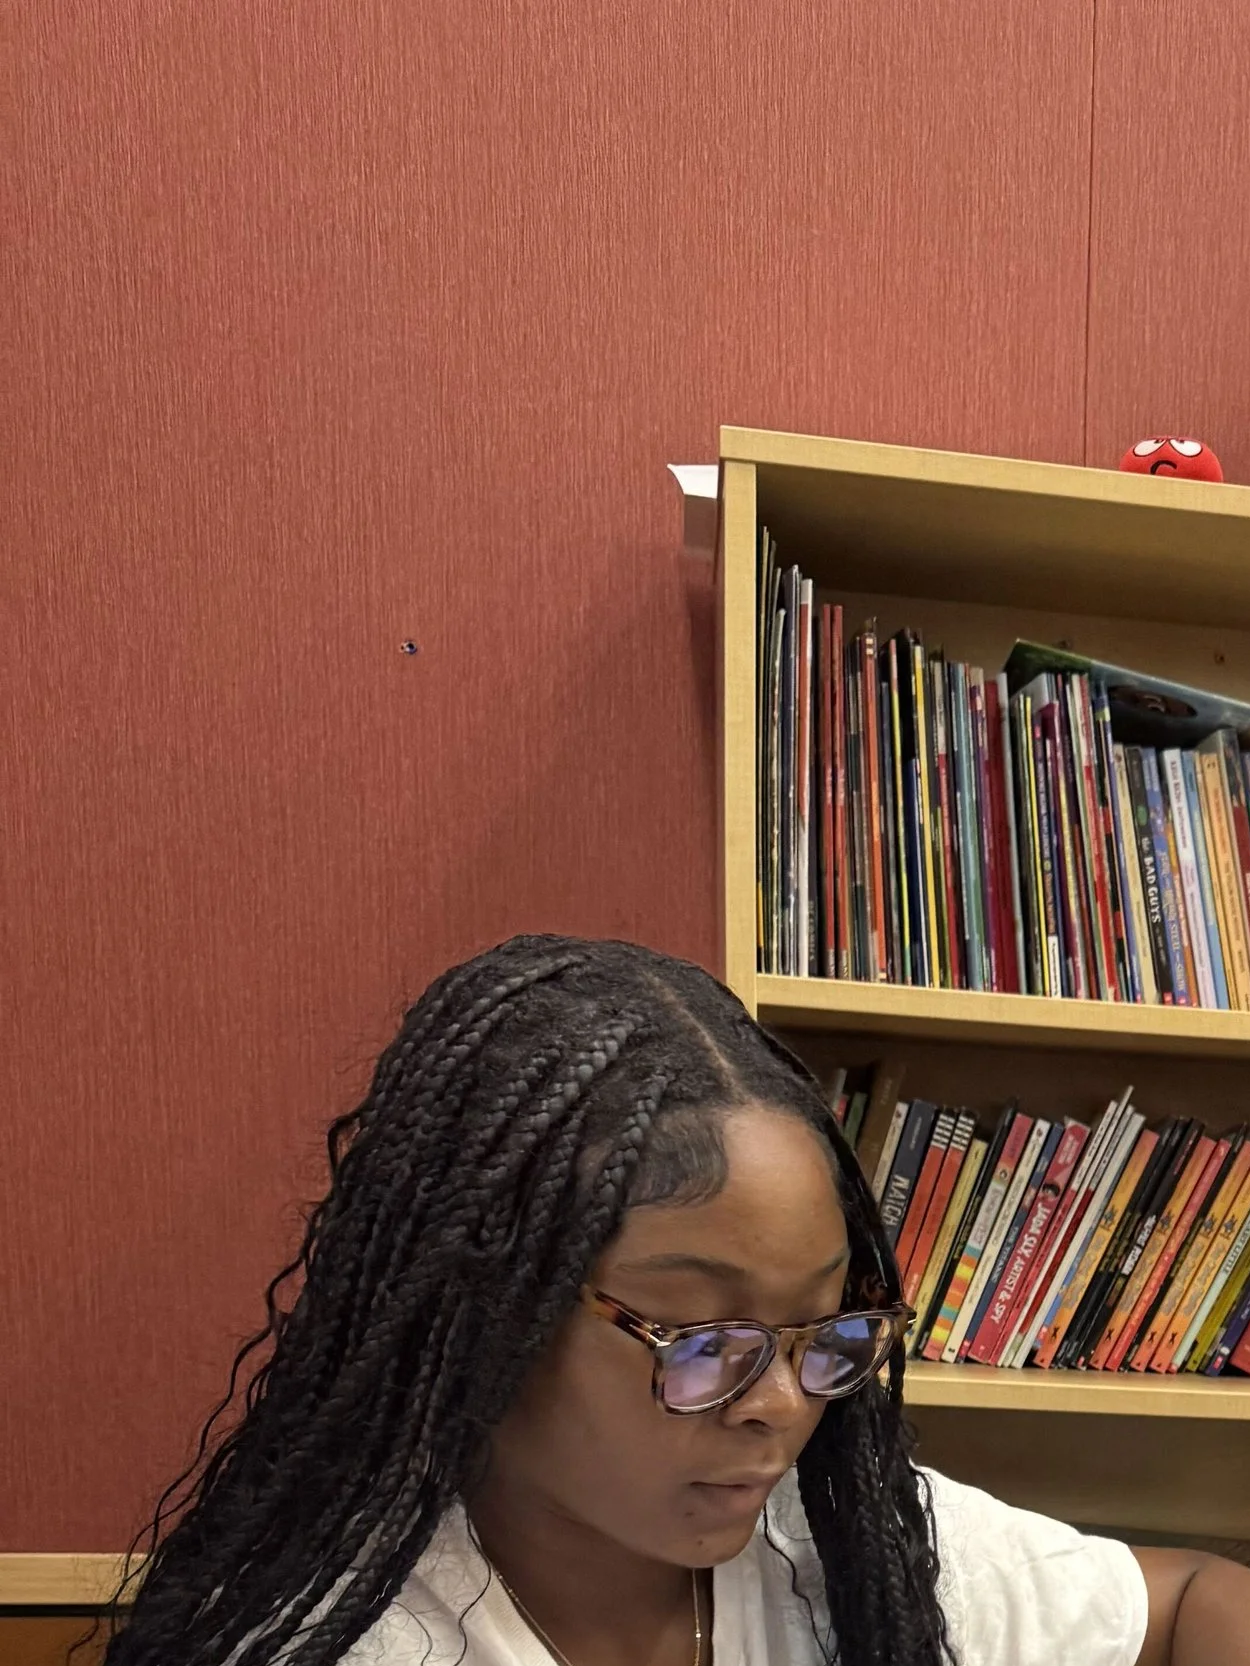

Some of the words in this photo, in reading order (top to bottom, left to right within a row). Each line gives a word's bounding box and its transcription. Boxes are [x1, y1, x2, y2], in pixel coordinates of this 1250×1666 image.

[1142, 855, 1157, 883] BAD
[1146, 885, 1162, 922] GUYS
[1027, 1202, 1051, 1235] JADA
[1007, 1225, 1020, 1243] THE
[1016, 1233, 1037, 1258] SLY,
[990, 1245, 1011, 1283] TITANIC
[1002, 1256, 1026, 1292] ARTIST
[1221, 1243, 1243, 1275] LITTLE
[997, 1290, 1011, 1303] &
[987, 1301, 1006, 1324] SPY
